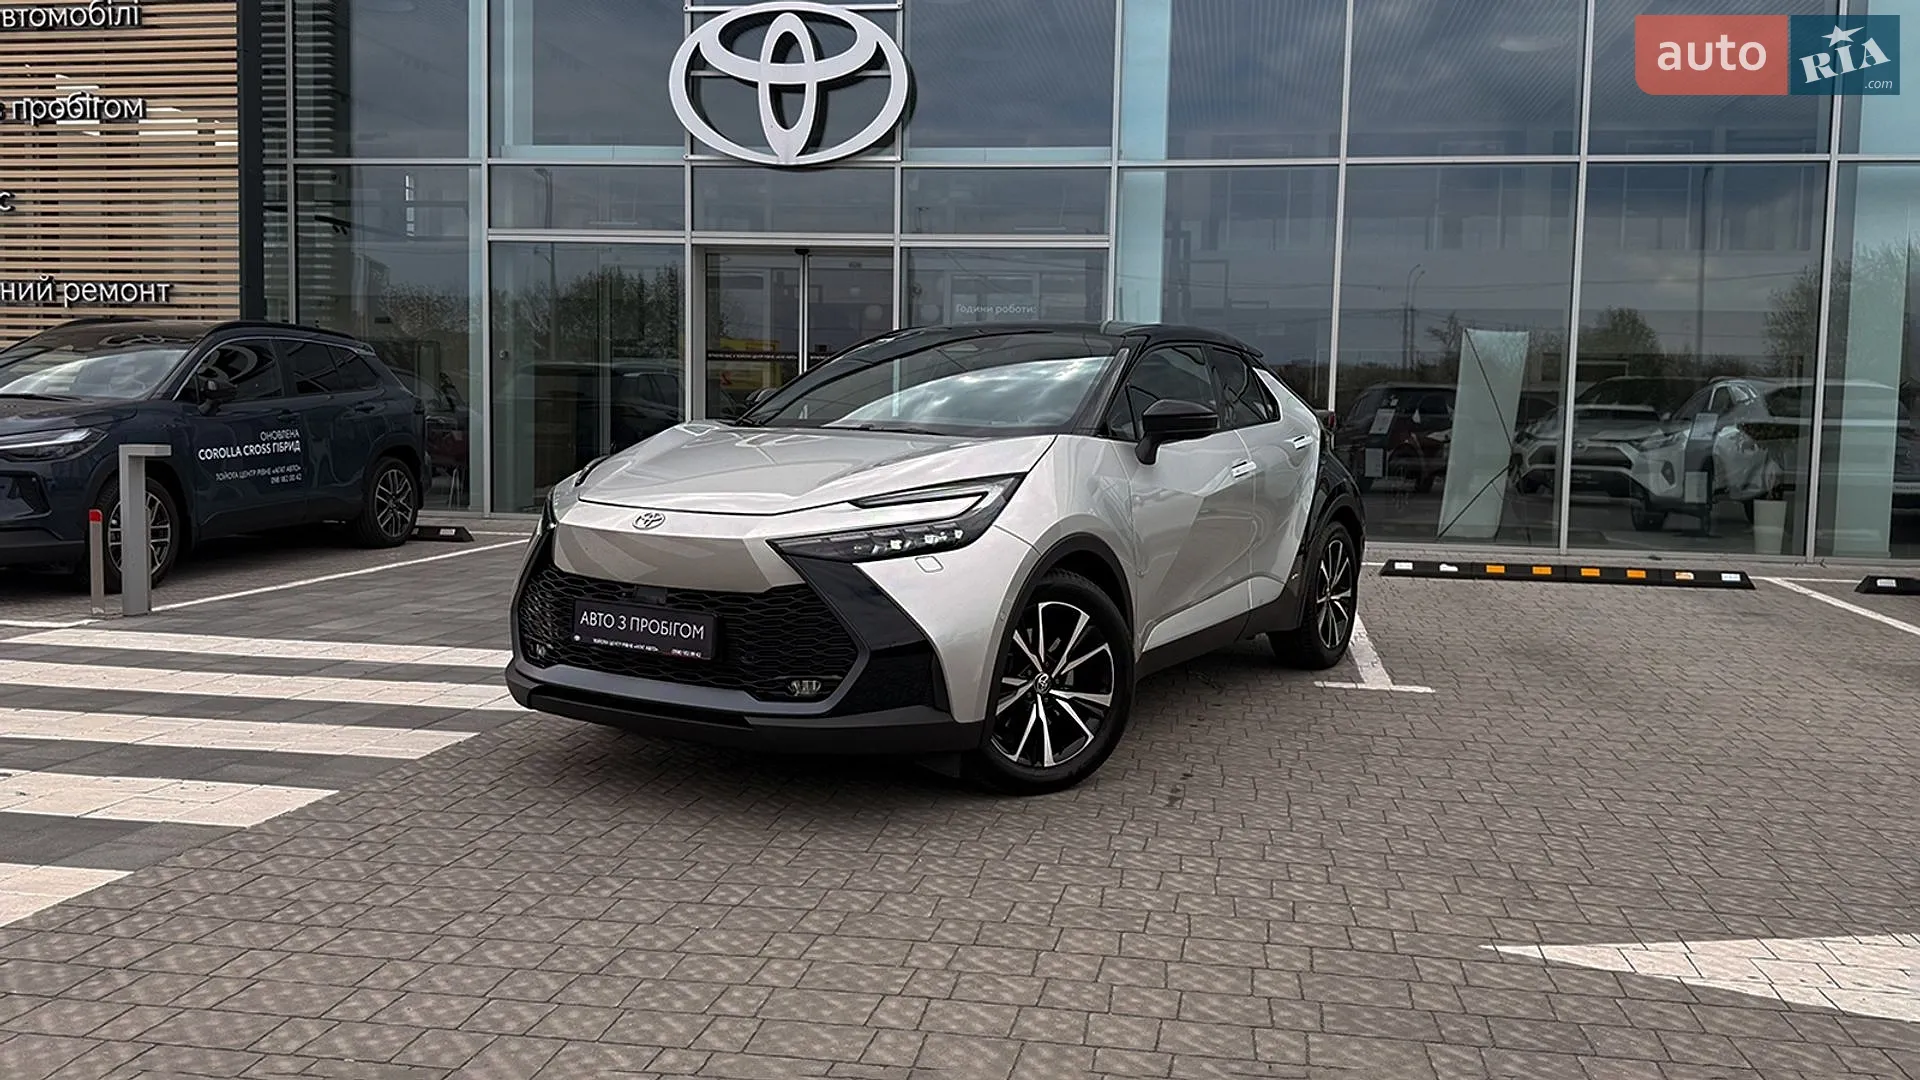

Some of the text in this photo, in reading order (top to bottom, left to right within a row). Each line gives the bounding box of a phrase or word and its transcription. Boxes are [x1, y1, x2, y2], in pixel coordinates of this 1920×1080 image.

[12, 92, 144, 126] пробігом
[64, 282, 170, 308] ремонт
[956, 304, 993, 314] Години
[260, 429, 300, 441] ОНОВЛЕНА
[198, 446, 242, 460] COROLLA
[243, 443, 271, 456] CROSS
[579, 611, 705, 640] АВТО З ПРОБІГОМ
